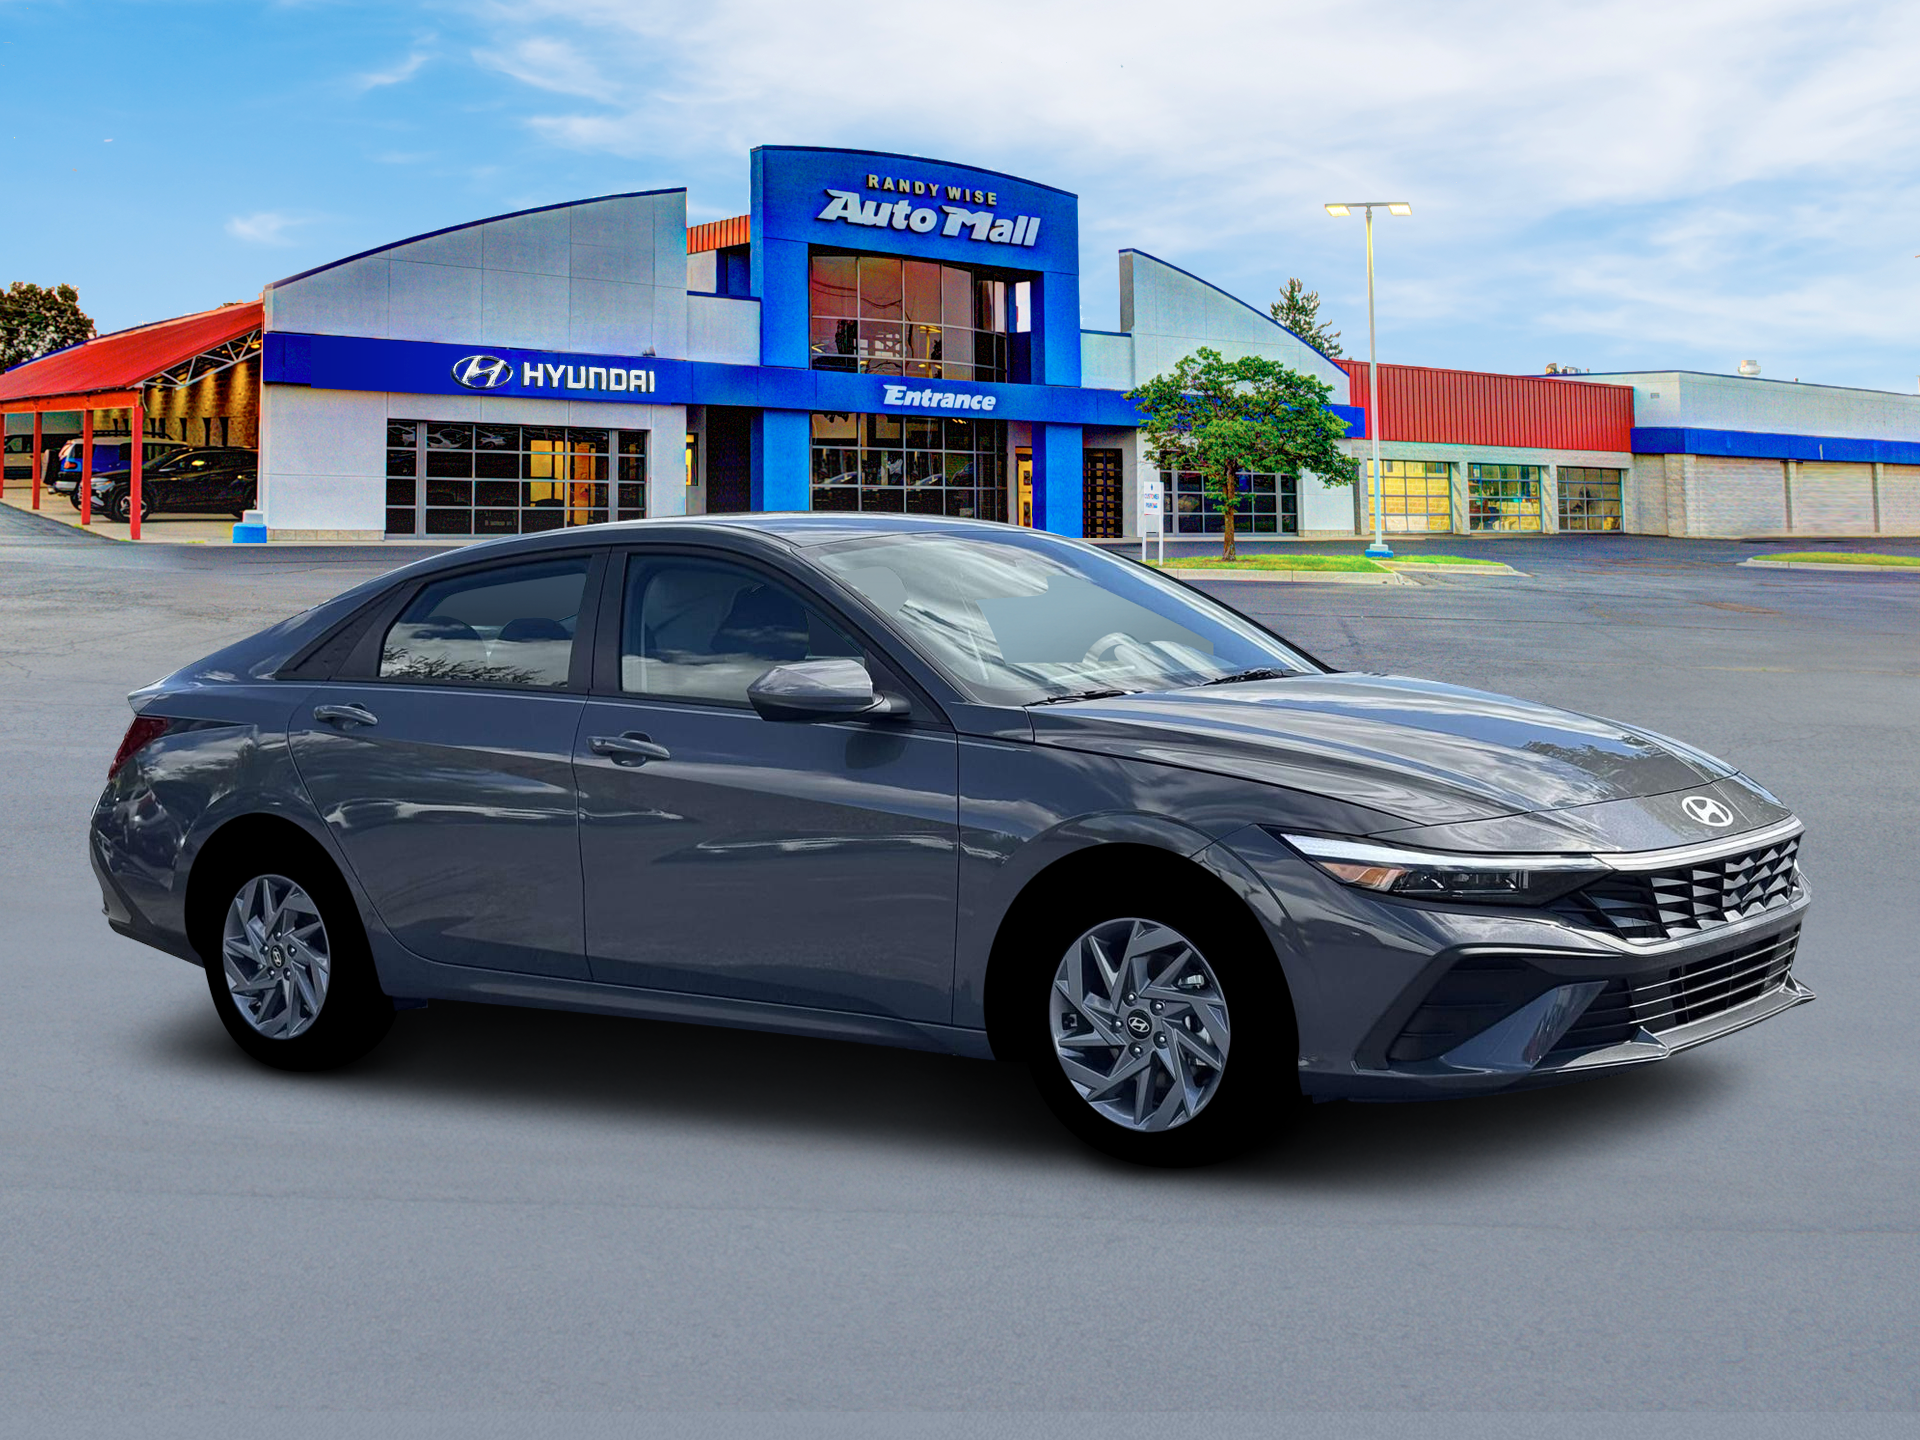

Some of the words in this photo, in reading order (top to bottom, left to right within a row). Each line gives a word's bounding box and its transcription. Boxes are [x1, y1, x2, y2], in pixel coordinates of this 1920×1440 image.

[867, 174, 940, 197] RANDY
[946, 186, 997, 206] WISE
[816, 188, 938, 233] Auto
[941, 205, 1041, 247] Mall
[522, 361, 656, 394] HYUNDAI
[882, 384, 997, 411] Entrance
